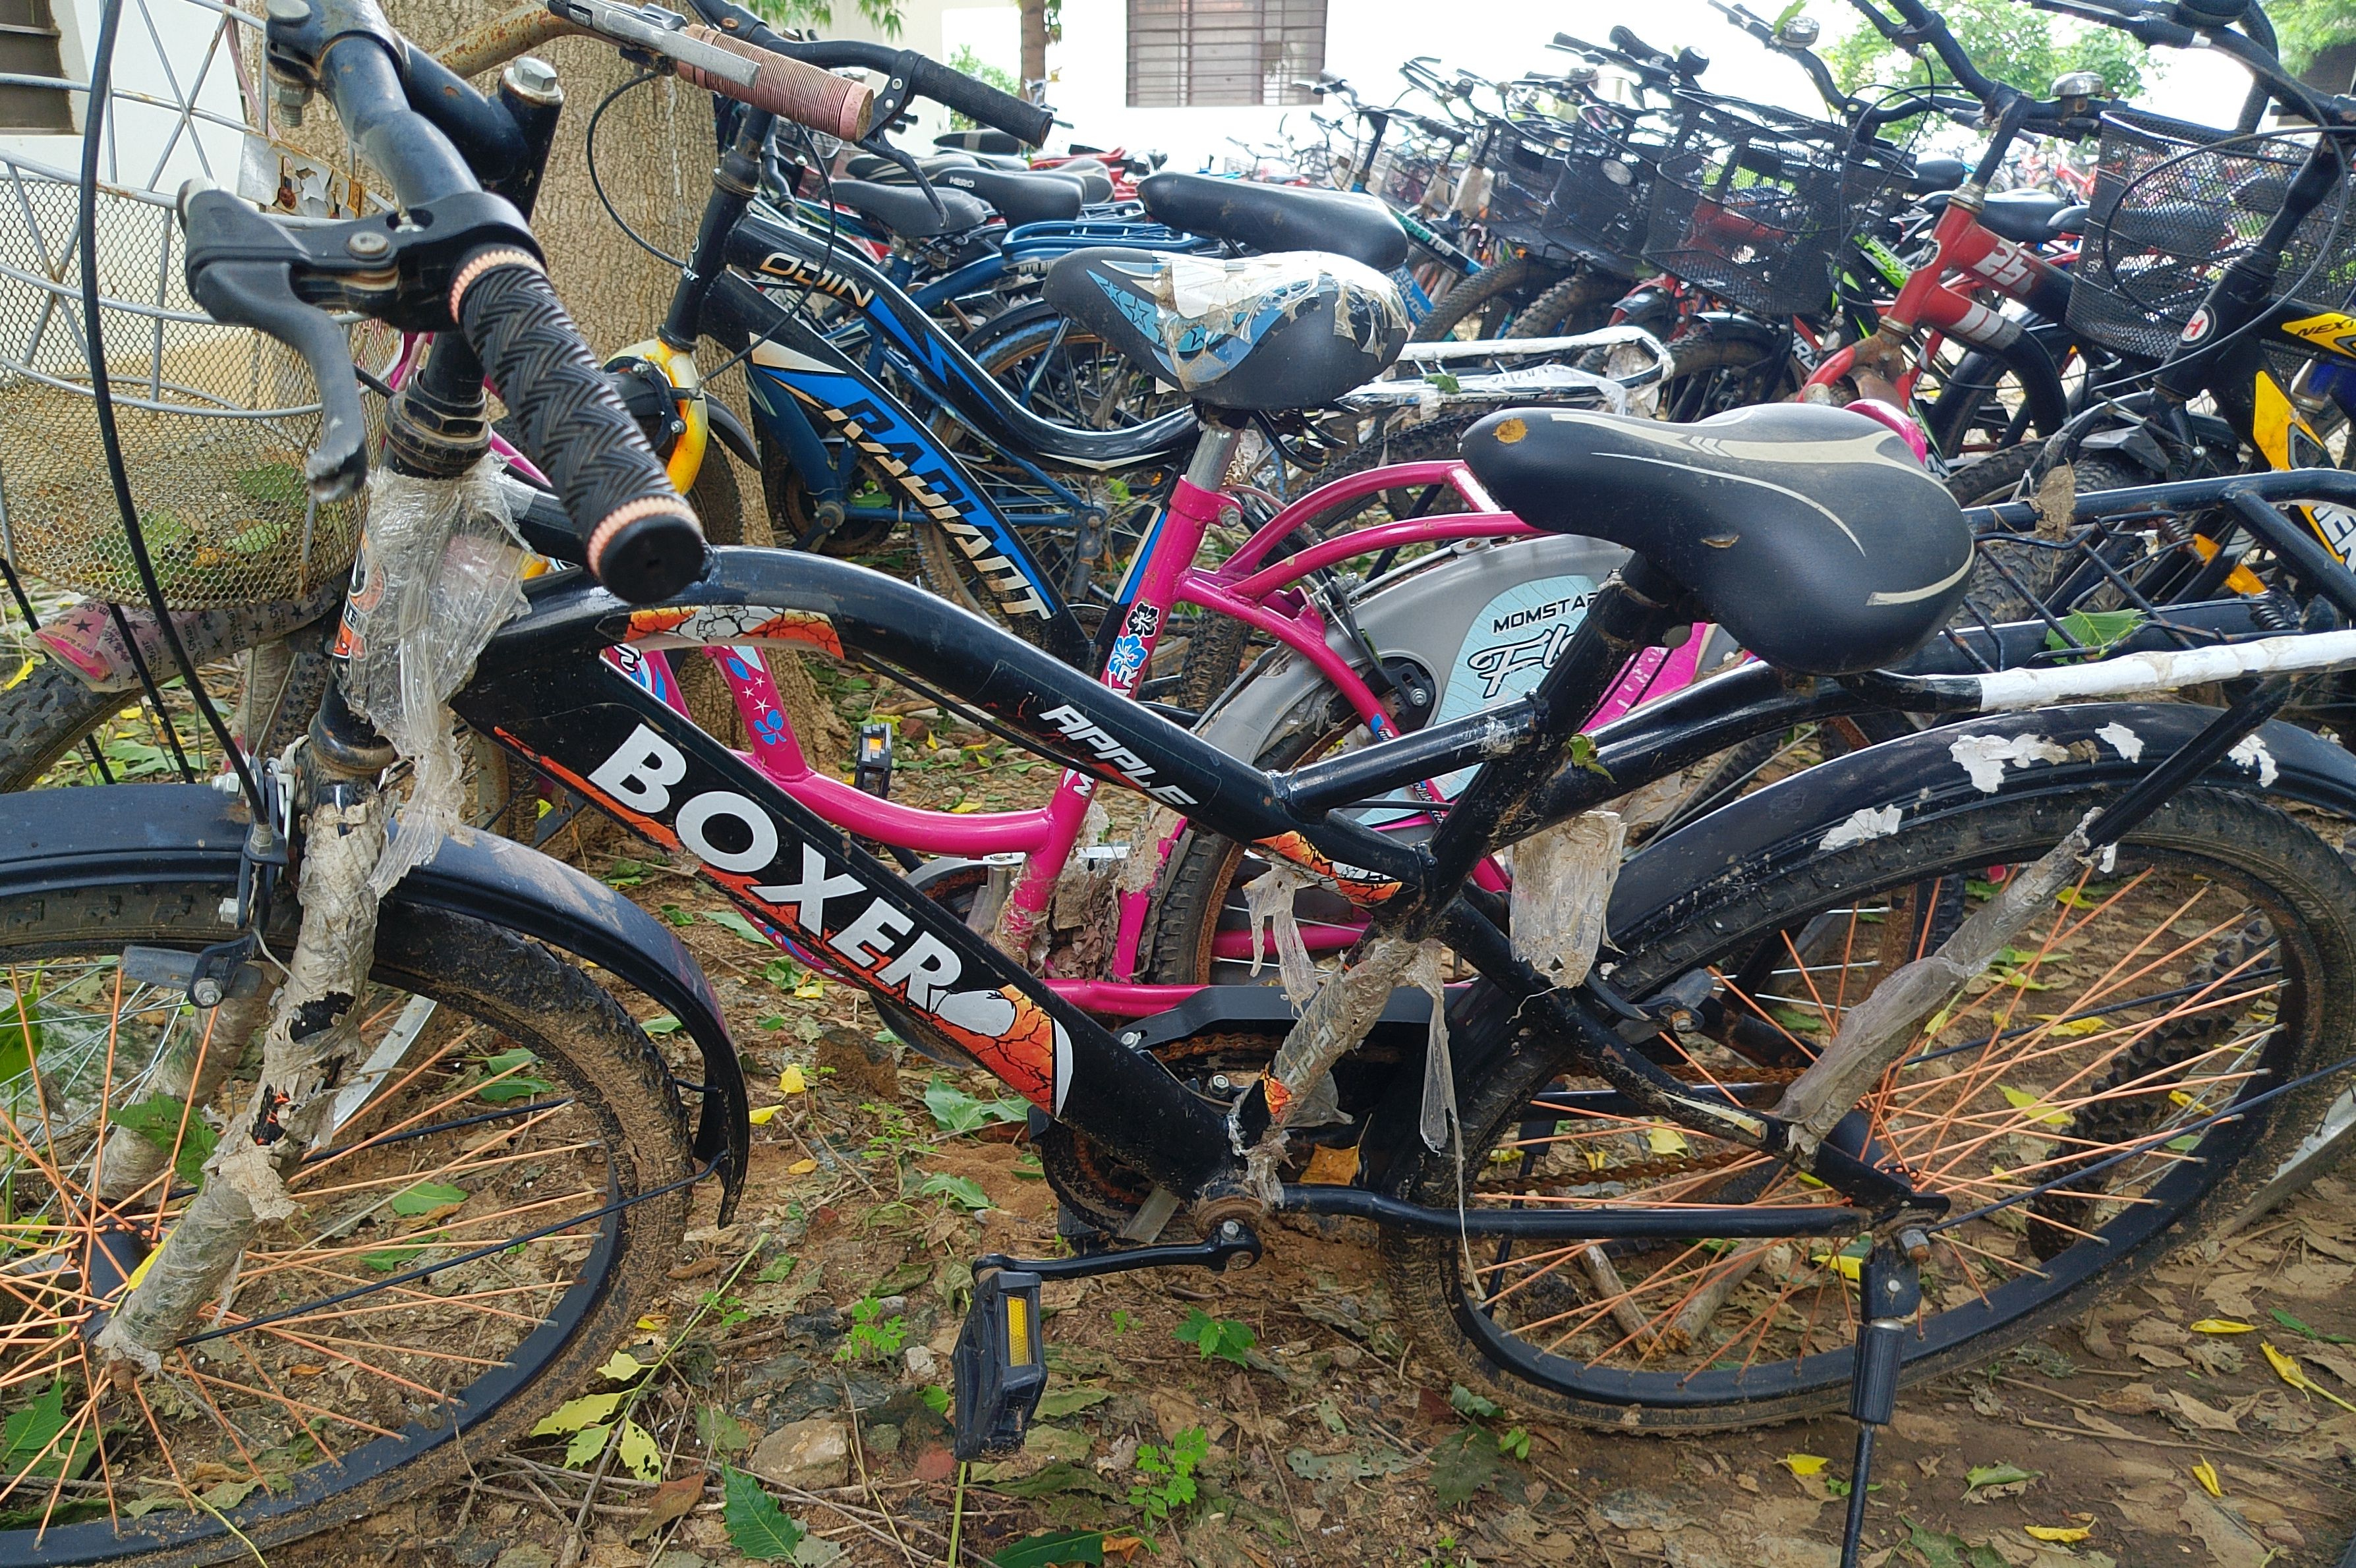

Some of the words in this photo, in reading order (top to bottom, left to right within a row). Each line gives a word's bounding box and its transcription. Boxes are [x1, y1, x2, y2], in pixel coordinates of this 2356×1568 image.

[759, 252, 875, 308] ODIN
[822, 398, 1057, 621] RADIANT
[1039, 704, 1199, 808] APPLE
[587, 723, 1017, 1038] BOXER
